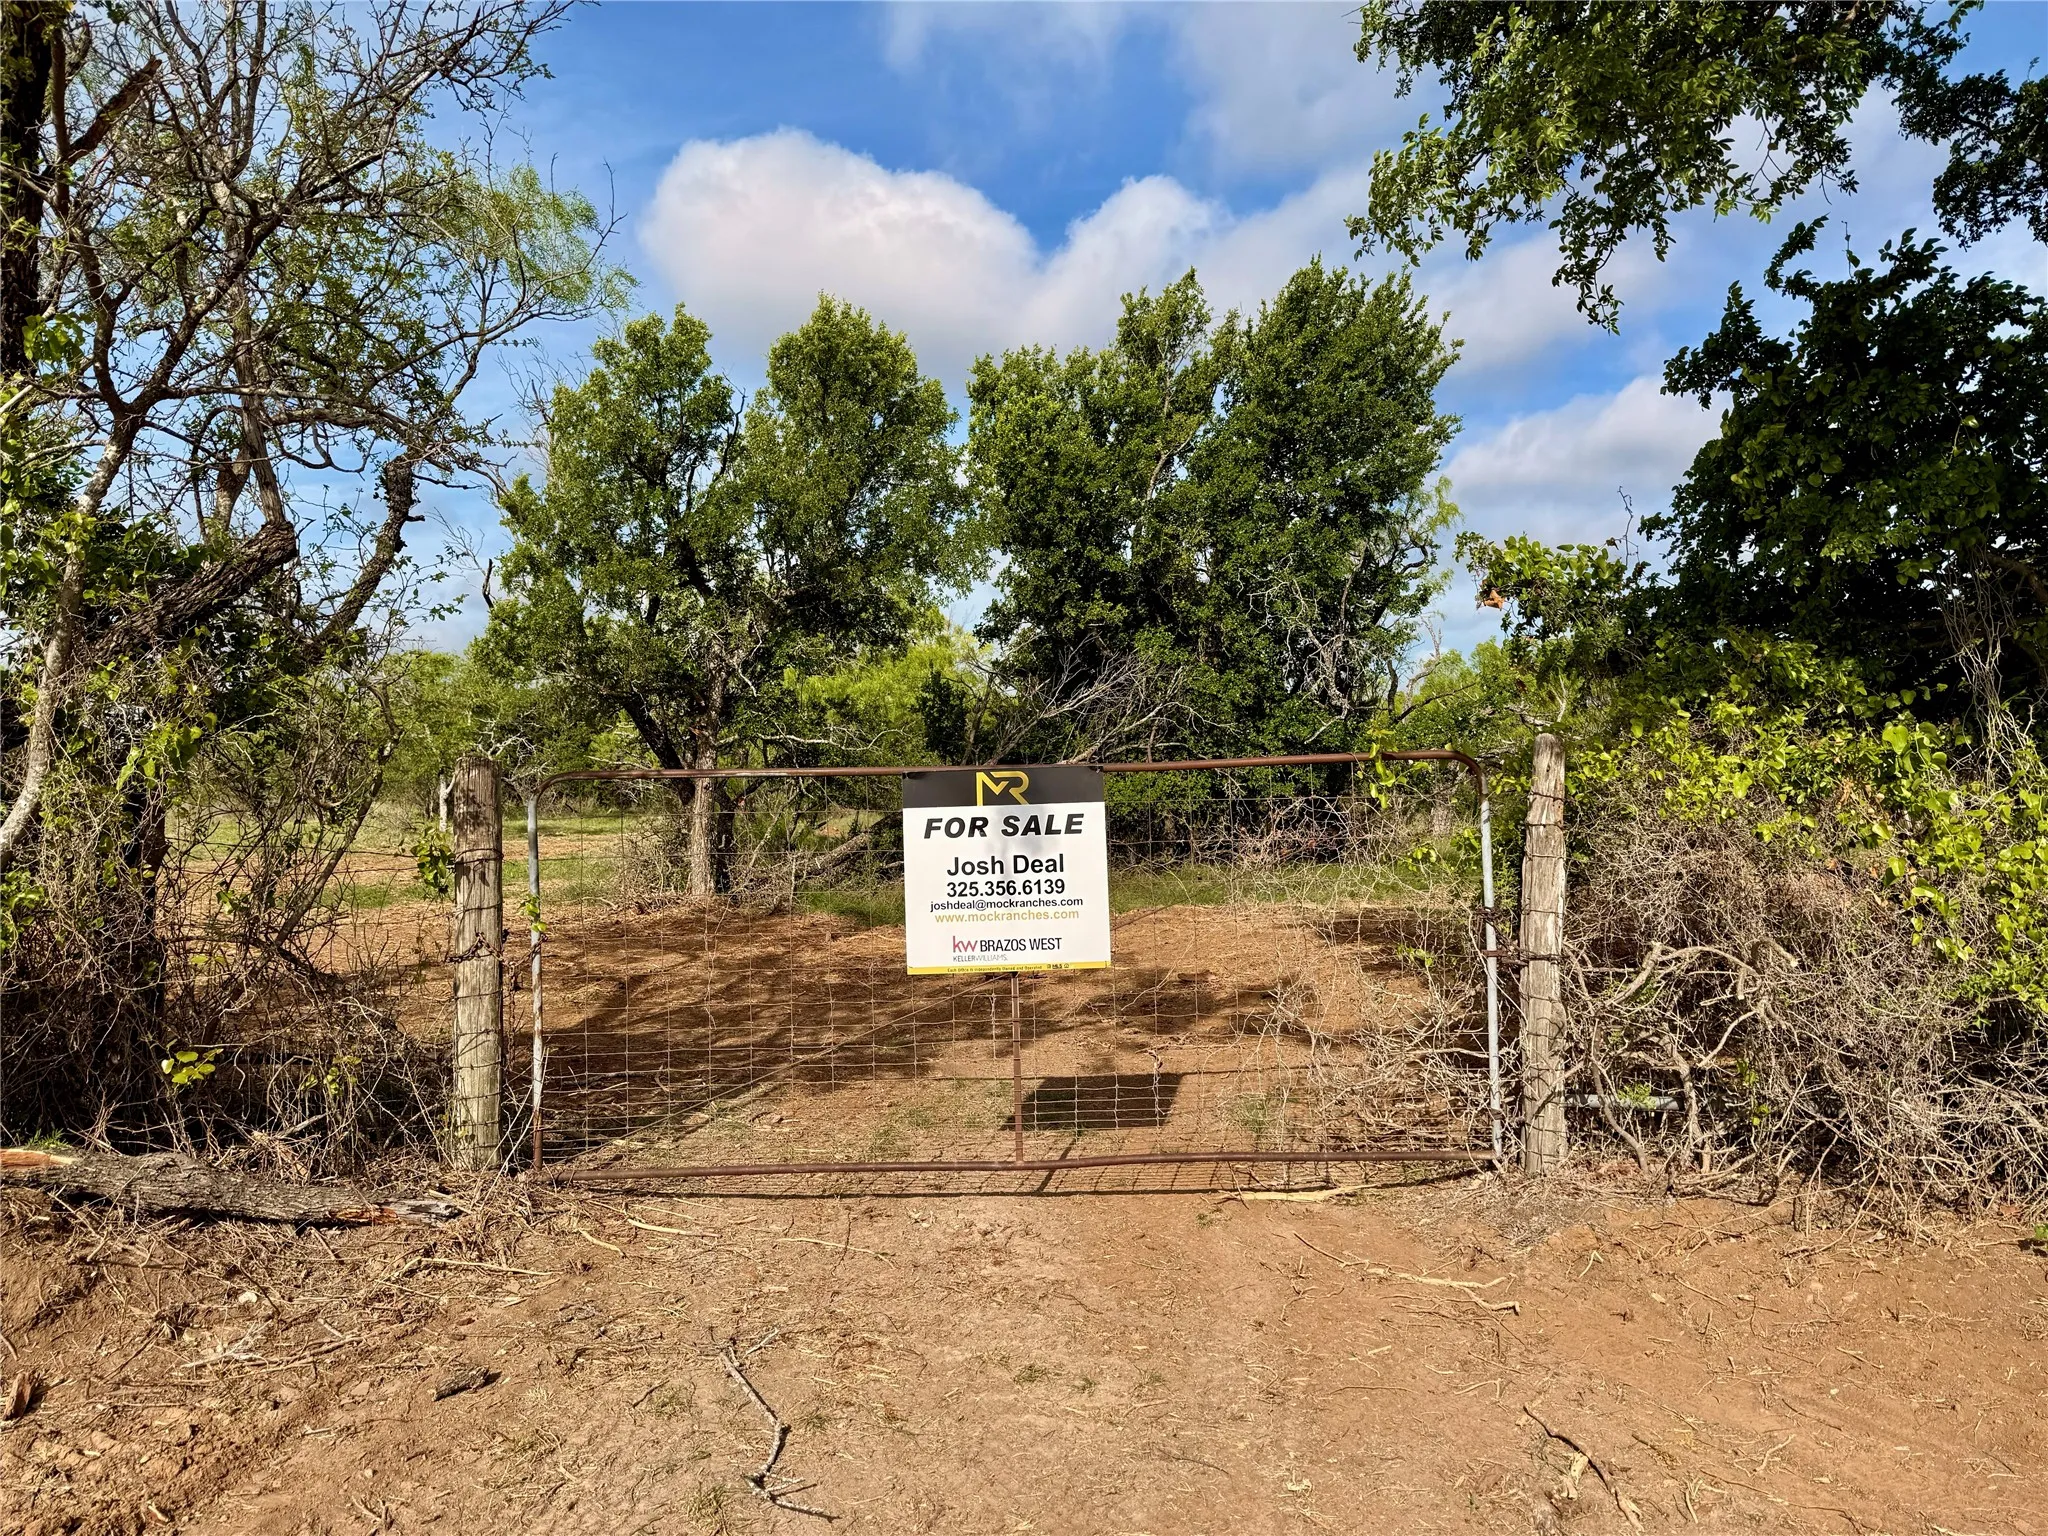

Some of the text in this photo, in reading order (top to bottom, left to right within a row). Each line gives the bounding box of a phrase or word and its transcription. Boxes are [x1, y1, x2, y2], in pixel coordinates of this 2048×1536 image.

[975, 770, 1030, 807] MR
[923, 813, 1084, 839] FOR SALE
[946, 853, 1064, 876] Josh Deal
[946, 878, 1065, 897] 325.356.6139
[930, 897, 1083, 913] joshdeal@mockranches.com
[934, 909, 1080, 923] www.mockranches.com
[952, 935, 1062, 953] kw BRAZOS WEST
